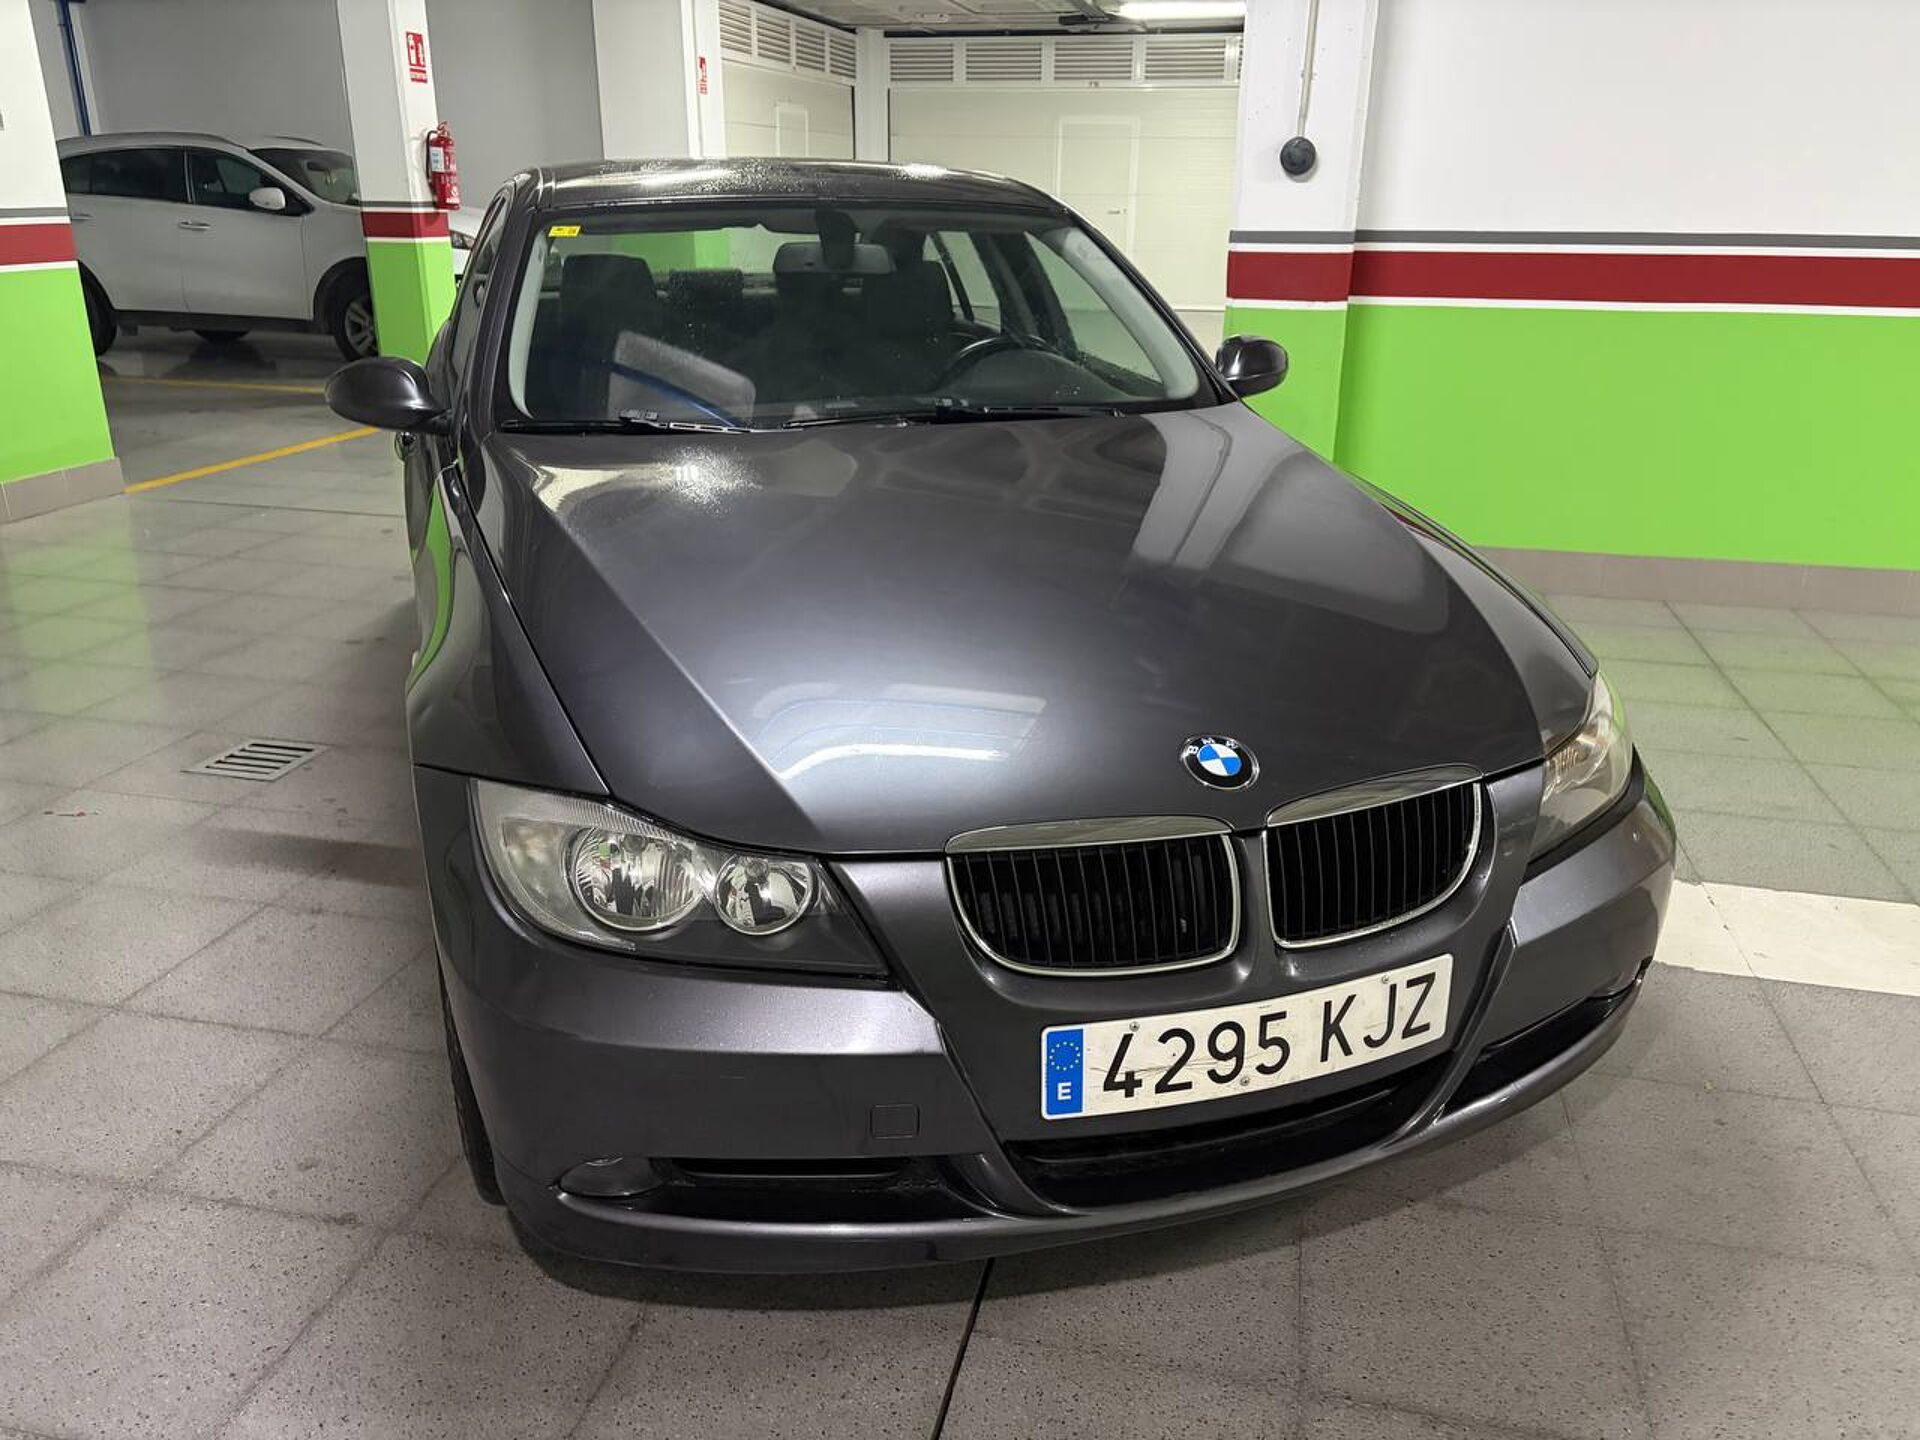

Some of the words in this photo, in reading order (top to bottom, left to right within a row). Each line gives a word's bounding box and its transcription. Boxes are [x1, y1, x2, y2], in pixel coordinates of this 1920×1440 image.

[1186, 737, 1239, 755] BMW
[1103, 1011, 1291, 1099] 4295
[1320, 972, 1436, 1063] KJZ
[1057, 1081, 1072, 1100] E
